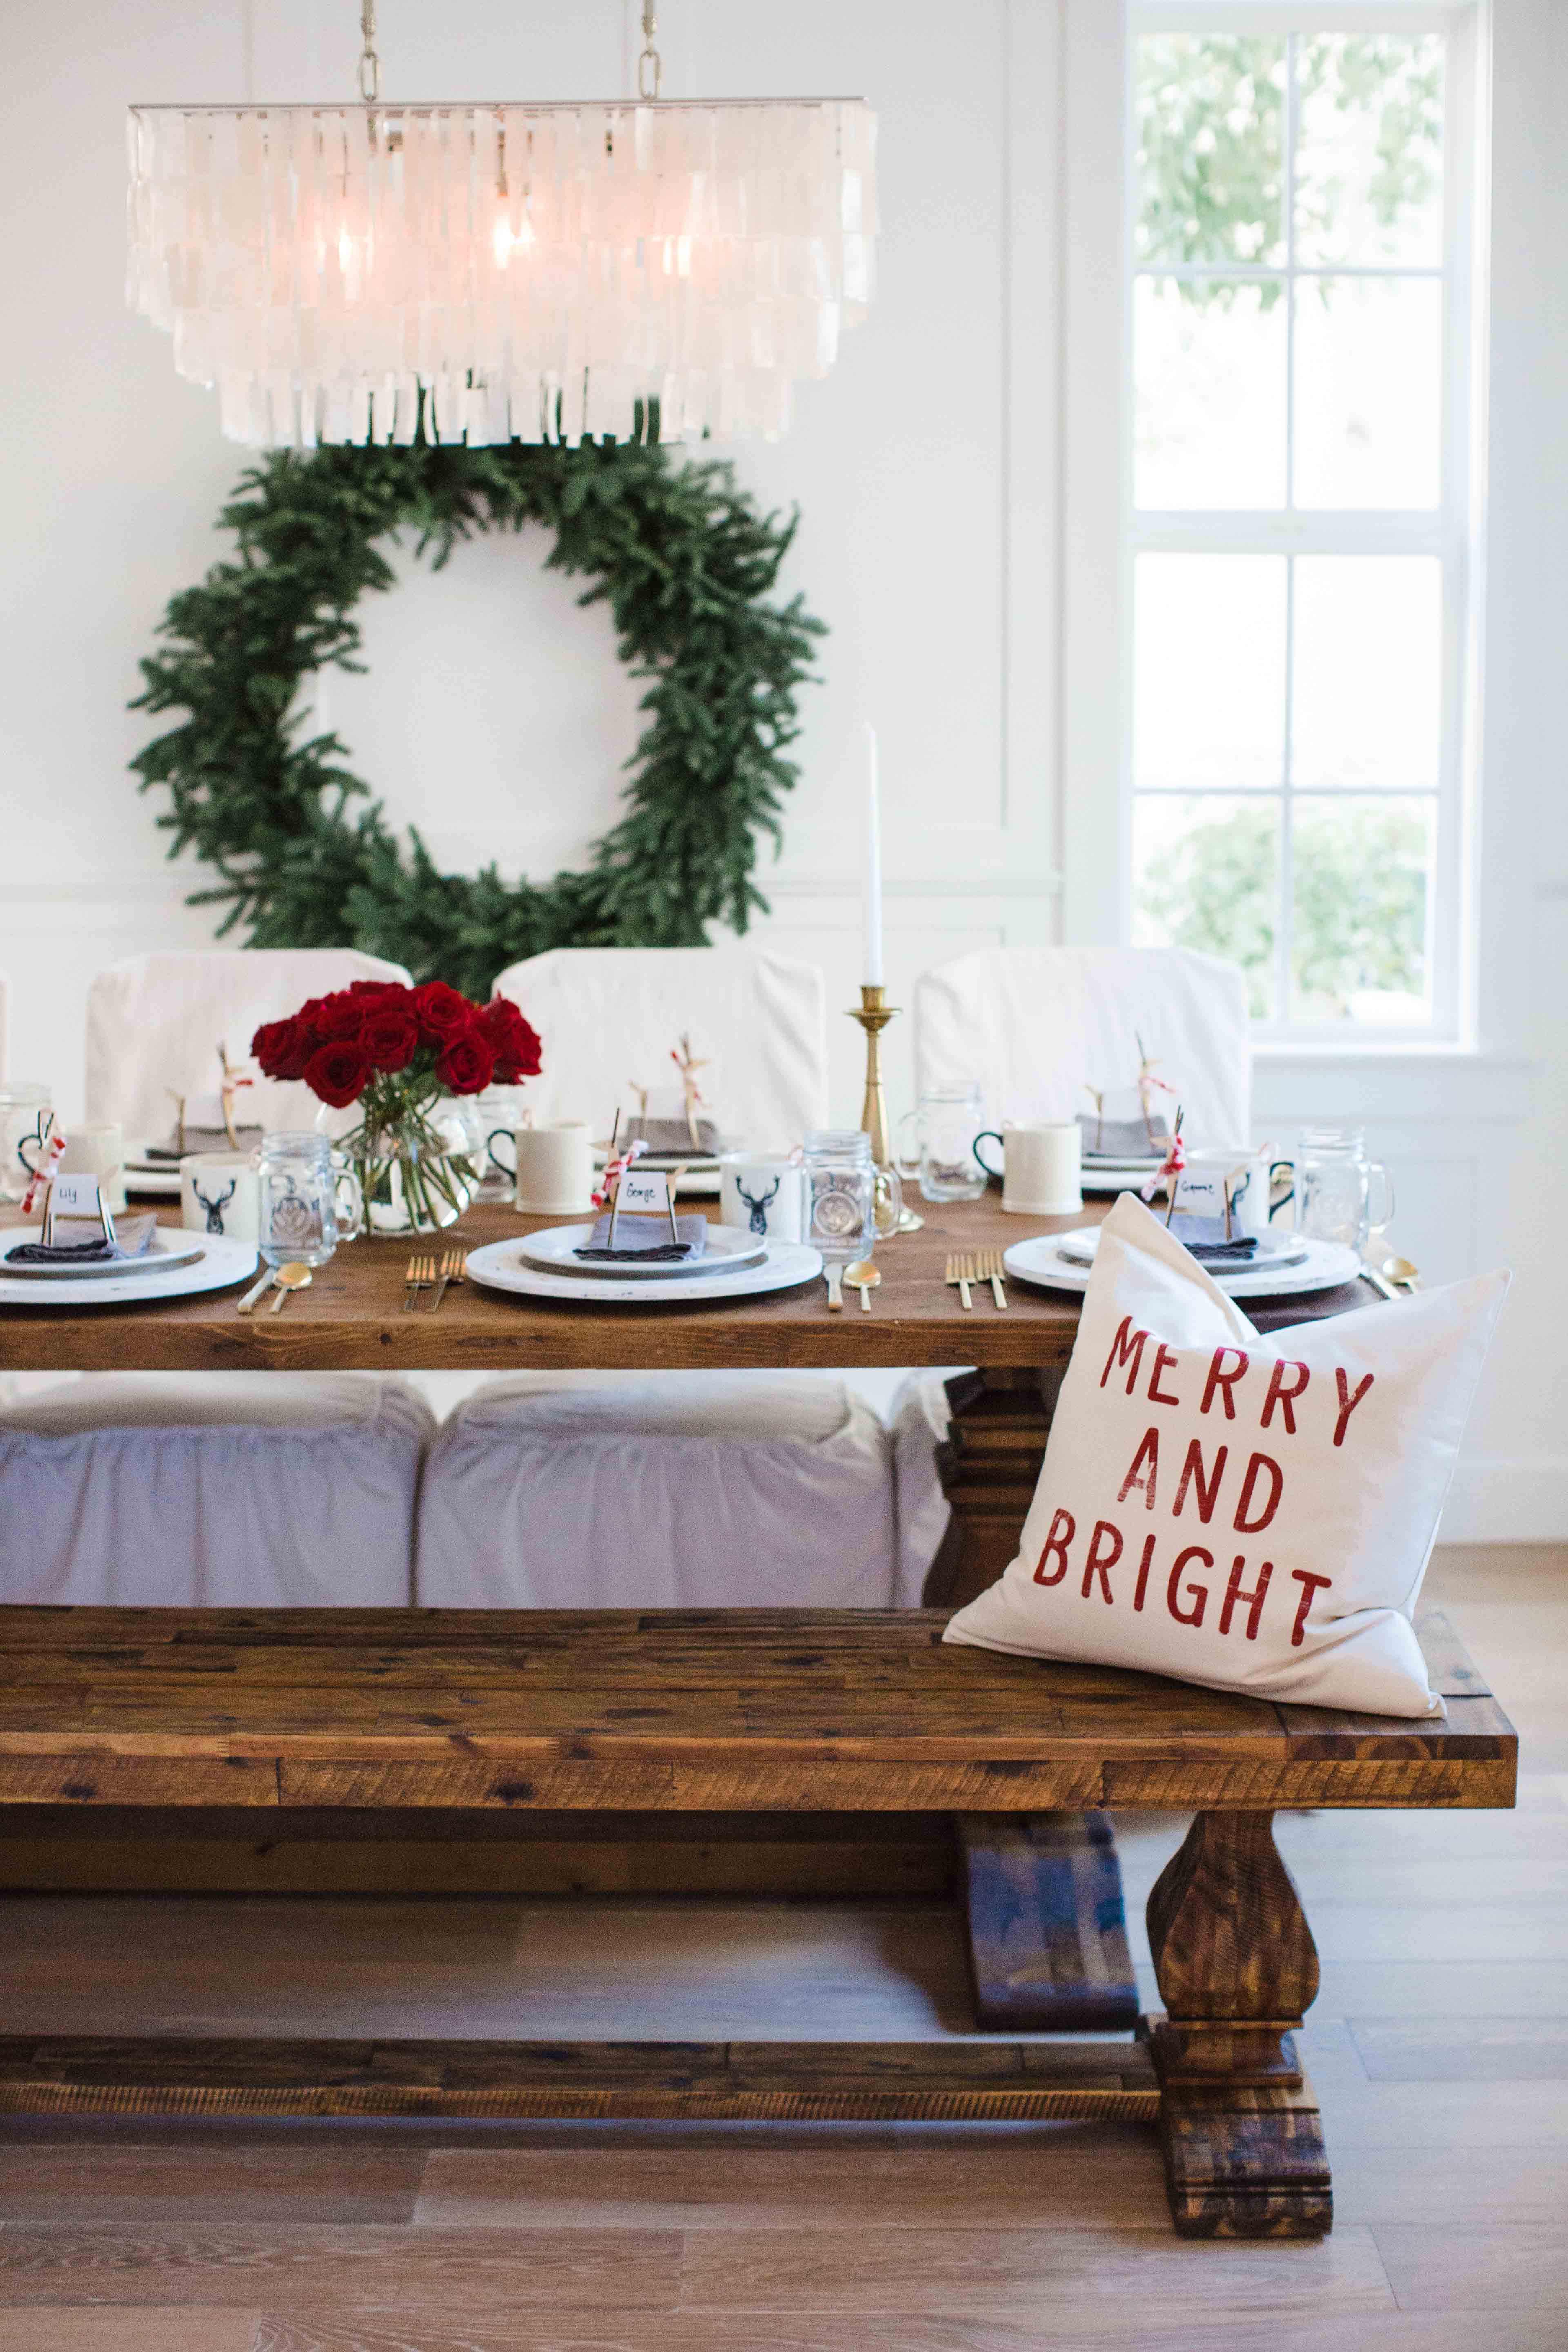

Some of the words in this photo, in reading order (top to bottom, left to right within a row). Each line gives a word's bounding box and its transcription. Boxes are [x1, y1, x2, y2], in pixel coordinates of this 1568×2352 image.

[1100, 1316, 1374, 1447] MERRY
[1118, 1427, 1283, 1534] AND
[1033, 1509, 1332, 1647] BRIGHT
